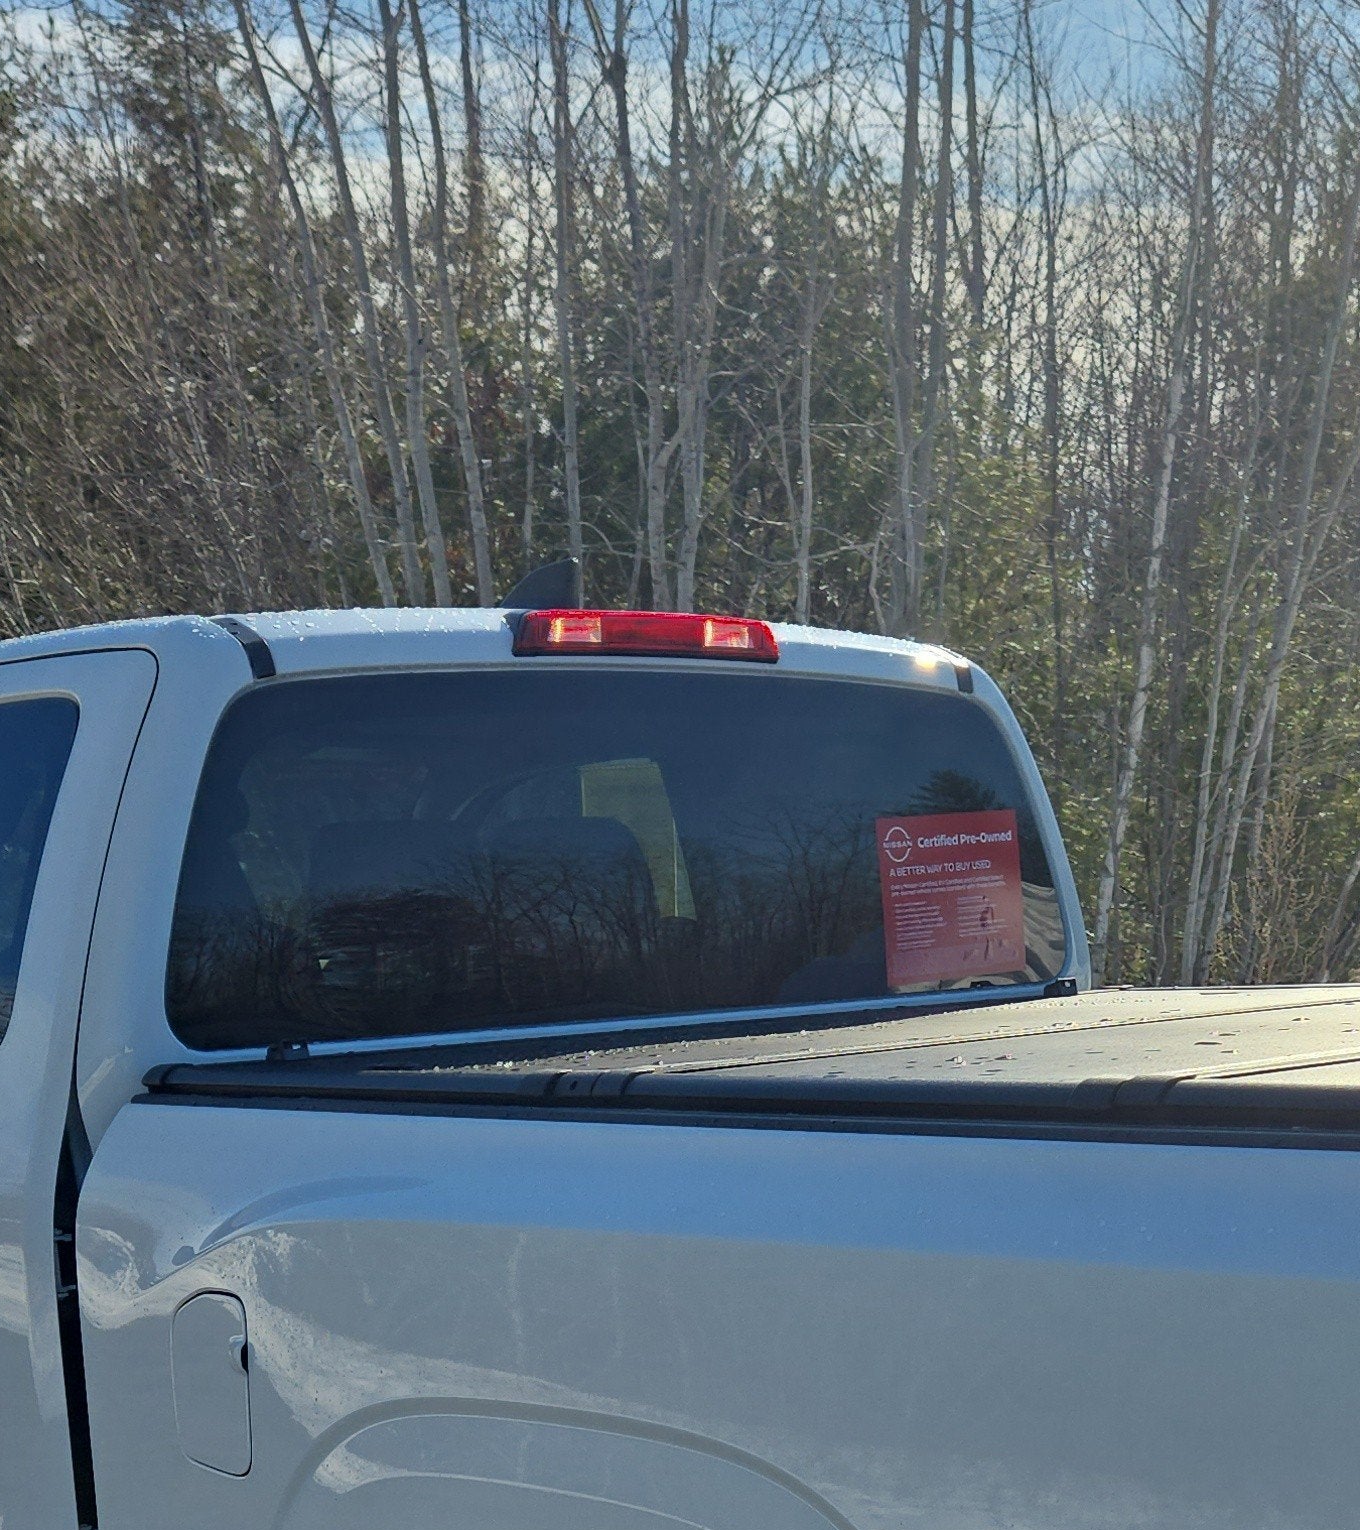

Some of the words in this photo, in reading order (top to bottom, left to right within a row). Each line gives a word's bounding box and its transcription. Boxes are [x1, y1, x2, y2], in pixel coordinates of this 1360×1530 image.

[883, 840, 912, 849] NISSAN
[917, 834, 958, 848] Certified
[959, 830, 1012, 845] Pre-Owned
[889, 868, 897, 877] A
[897, 865, 925, 876] BETTER
[927, 864, 942, 873] WAY
[943, 863, 954, 872] TO
[955, 861, 971, 871] BUY
[971, 860, 991, 869] USED
